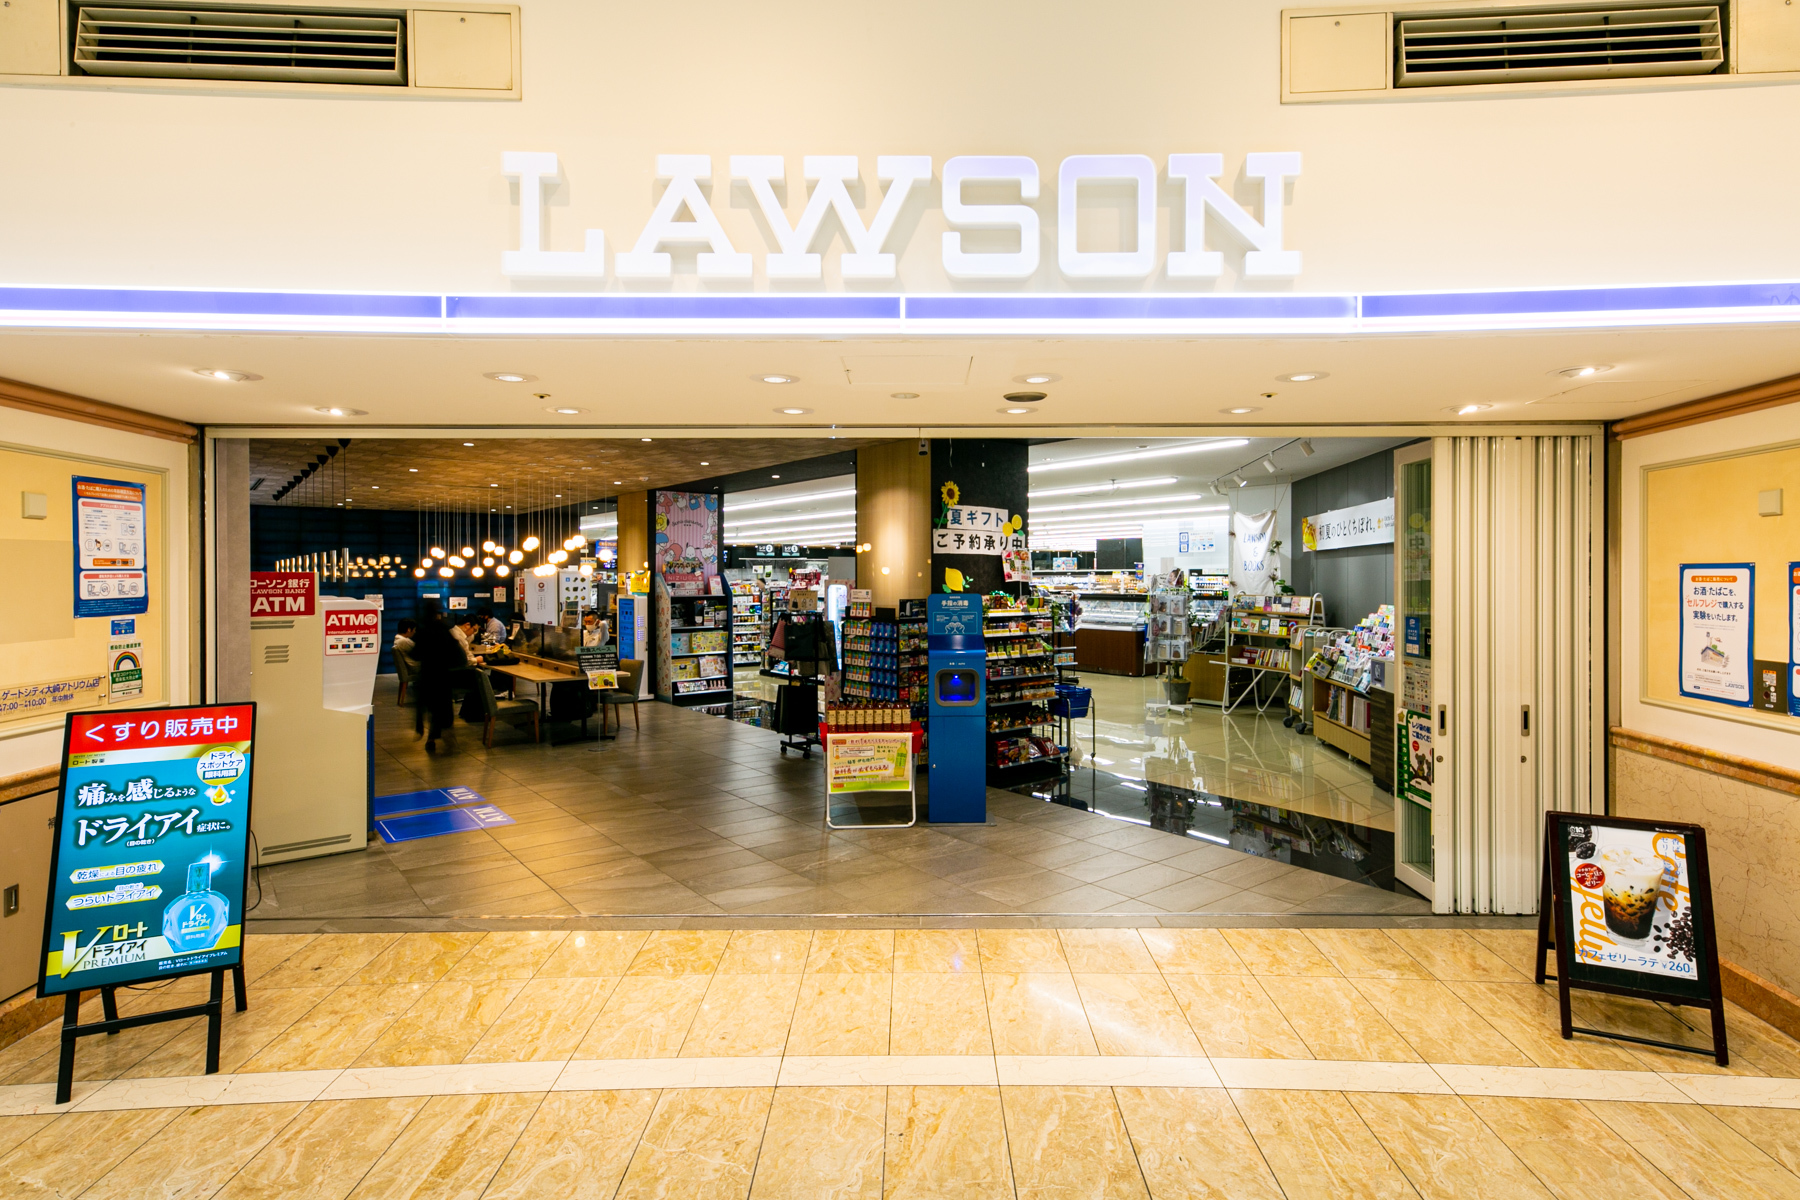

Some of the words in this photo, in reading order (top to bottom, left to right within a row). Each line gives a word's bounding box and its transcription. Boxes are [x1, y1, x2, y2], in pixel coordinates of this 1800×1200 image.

[501, 151, 1303, 279] LAWSON
[950, 508, 1004, 528] 夏ギフト
[936, 533, 1023, 550] ご予約承り中
[1243, 560, 1265, 571] BOOKS
[250, 578, 311, 589] ローソン銀行
[252, 596, 306, 613] ATM
[326, 614, 365, 627] ATM
[2, 678, 100, 700] ゲートシティ大崎アトリウム店
[85, 715, 238, 742] くすり販売中
[72, 757, 105, 766] ロート製薬
[200, 759, 243, 769] スポットケア
[210, 751, 235, 760] ドライ
[78, 779, 196, 807] 痛みを感じるような
[77, 863, 158, 880] 乾燥による目の疲れ
[73, 888, 155, 907] つらいドライアイ
[113, 921, 148, 942] ロート
[182, 918, 212, 929] ドライアイ
[92, 939, 148, 958] ドライアイ
[83, 952, 146, 969] PREMIUM
[1578, 948, 1659, 968] カフェゼリーラテ
[1662, 961, 1691, 973] ¥260
